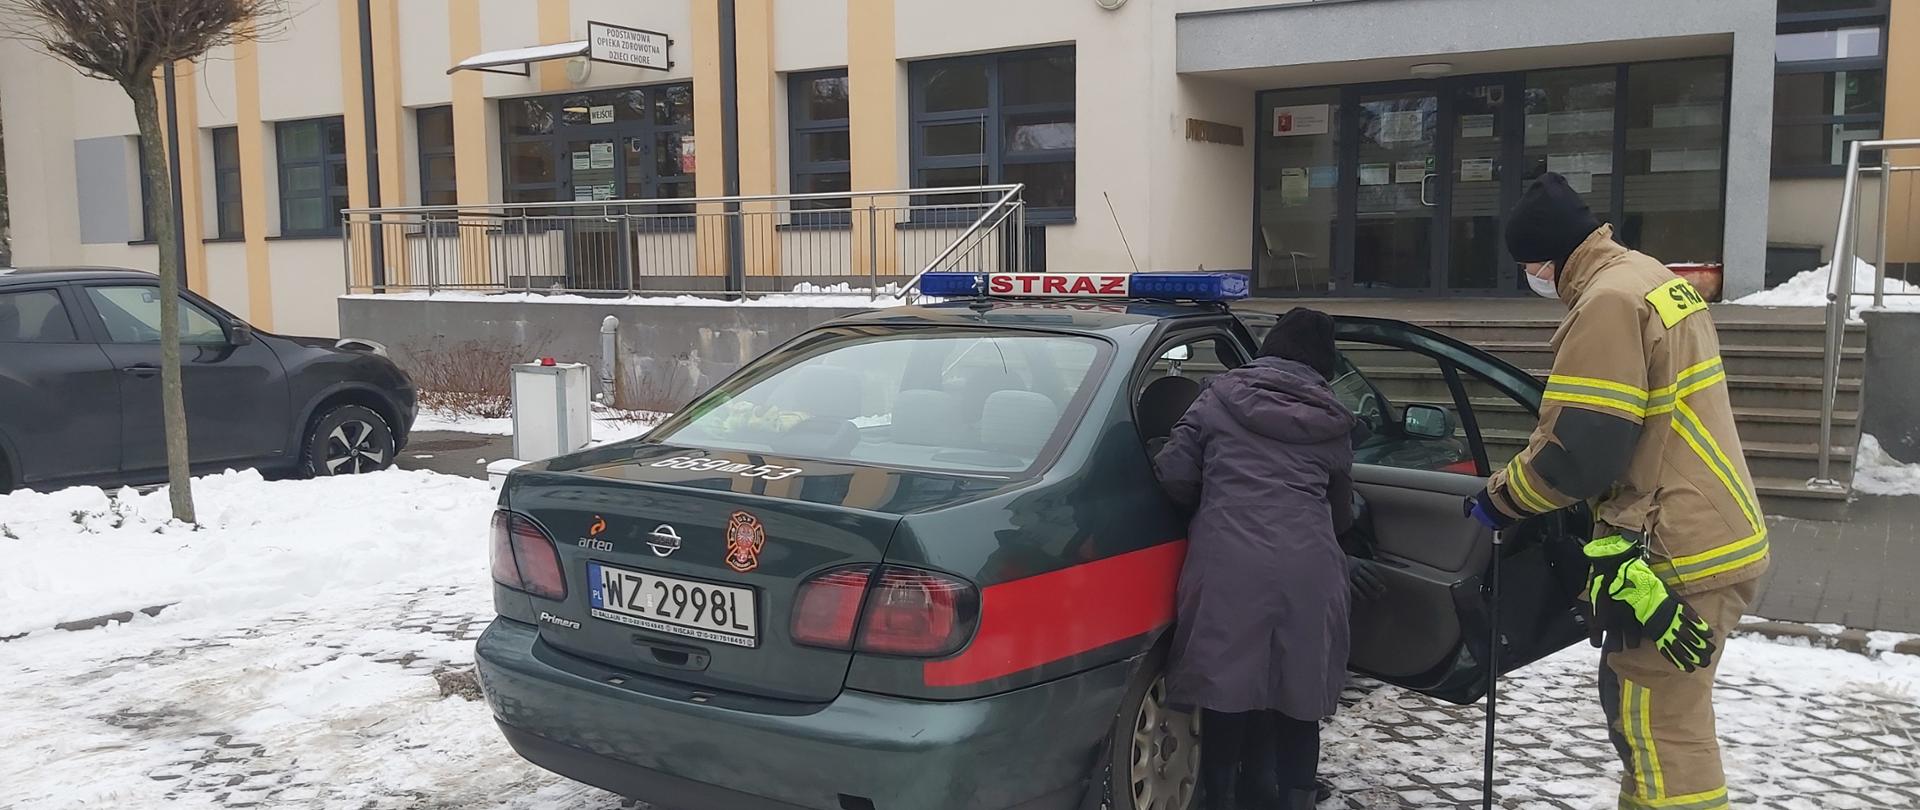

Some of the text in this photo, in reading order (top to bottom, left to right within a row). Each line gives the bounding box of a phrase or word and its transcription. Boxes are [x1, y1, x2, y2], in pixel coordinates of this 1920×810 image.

[606, 28, 651, 44] PODSTAWOWA
[597, 37, 660, 54] OPIEKA ZDROWOTNA
[608, 51, 650, 65] DZIECI CHORE
[578, 537, 614, 552] arteo
[593, 589, 603, 601] PL
[605, 571, 749, 631] WZ 2998L
[540, 611, 581, 630] Primera
